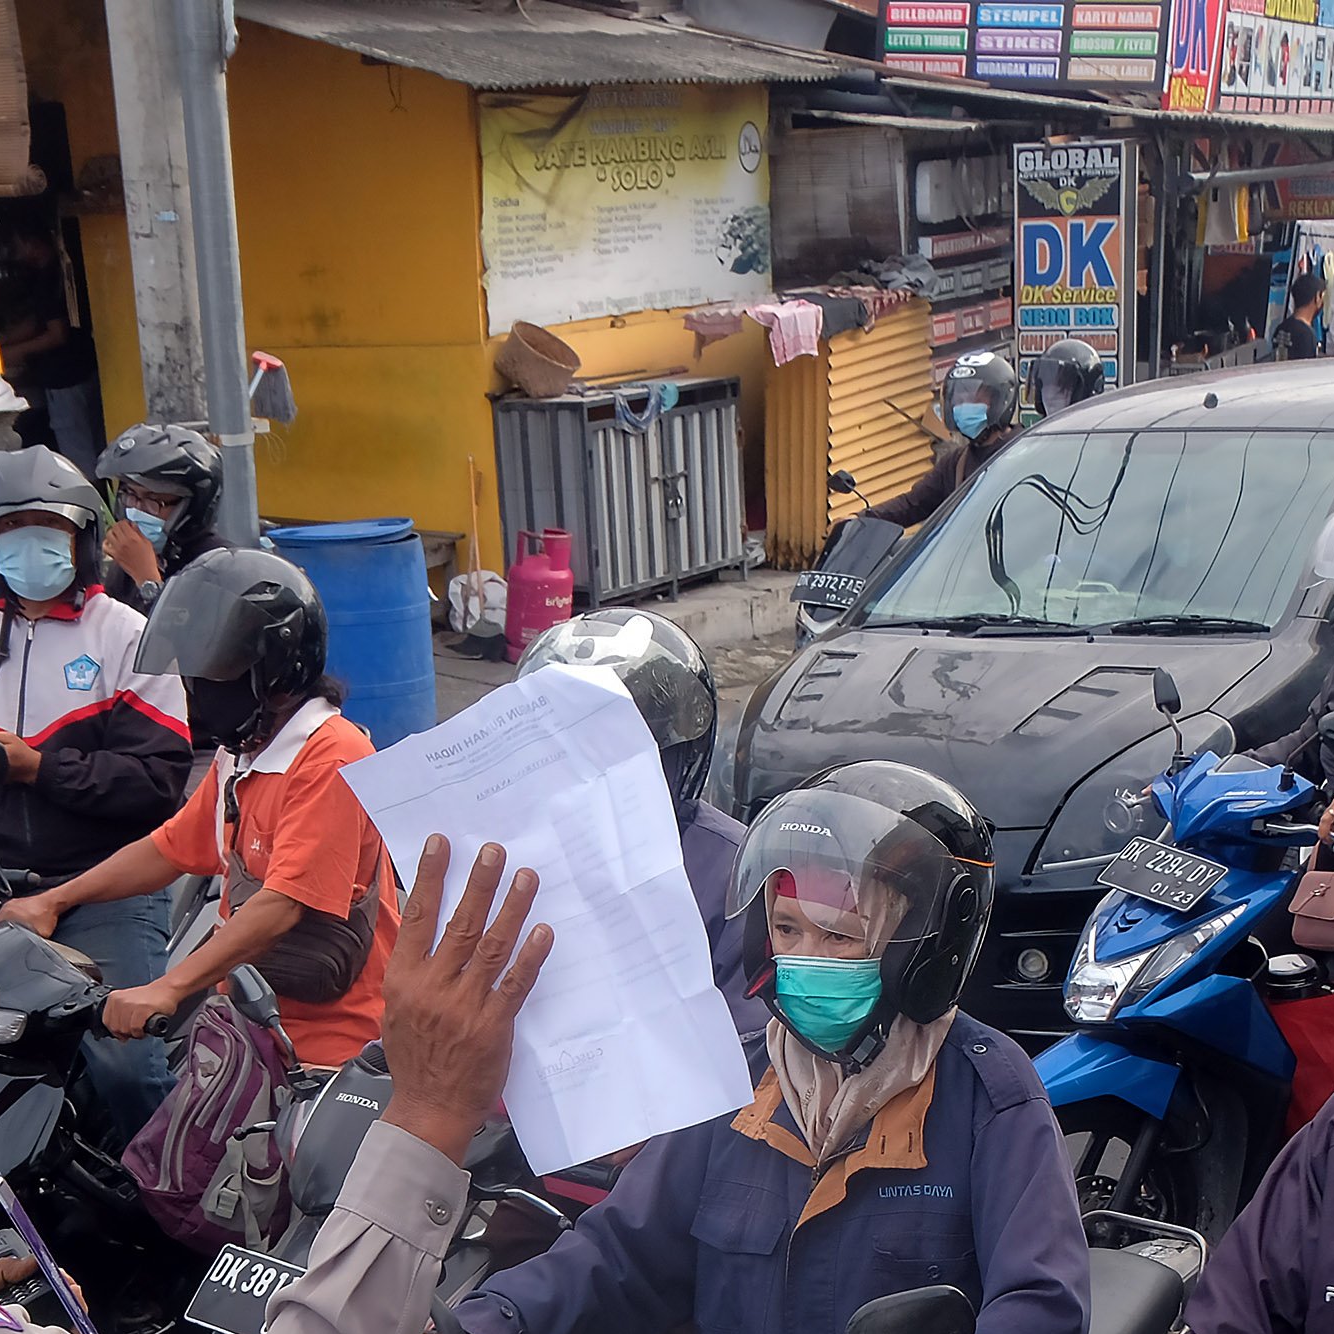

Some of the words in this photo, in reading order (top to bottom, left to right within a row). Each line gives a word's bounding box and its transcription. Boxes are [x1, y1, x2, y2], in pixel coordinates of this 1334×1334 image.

[890, 5, 964, 22] BILLBOARD
[979, 6, 1060, 23] STEMPEL
[1075, 7, 1117, 24] KARTU
[1117, 8, 1154, 25] NAMA
[887, 33, 922, 48] LETTER
[923, 33, 962, 48] TIMBUL
[979, 34, 1055, 50] STIKER
[1073, 35, 1115, 51] BROSUR
[1123, 35, 1153, 52] FLYER
[1173, 0, 1208, 75] DK
[1028, 62, 1056, 78] MENU
[1119, 62, 1149, 78] LABEL
[535, 142, 586, 171] SATE
[590, 135, 686, 166] KAMBING
[689, 134, 727, 162] ASLI
[1018, 147, 1120, 172] GLOBAL
[1058, 176, 1078, 188] DK
[1021, 218, 1119, 289] DK
[1021, 284, 1046, 304] DK
[1051, 284, 1116, 304] Service
[1020, 308, 1070, 327] NEON
[1074, 307, 1115, 326] BOX
[779, 822, 833, 838] HONDA
[1120, 840, 1150, 862] DK
[1145, 850, 1193, 878] 2294
[1185, 866, 1220, 888] DY
[335, 1092, 379, 1112] HONDA
[879, 1185, 921, 1198] LINTAS
[923, 1185, 954, 1198] DAYA
[209, 1252, 251, 1292] DK
